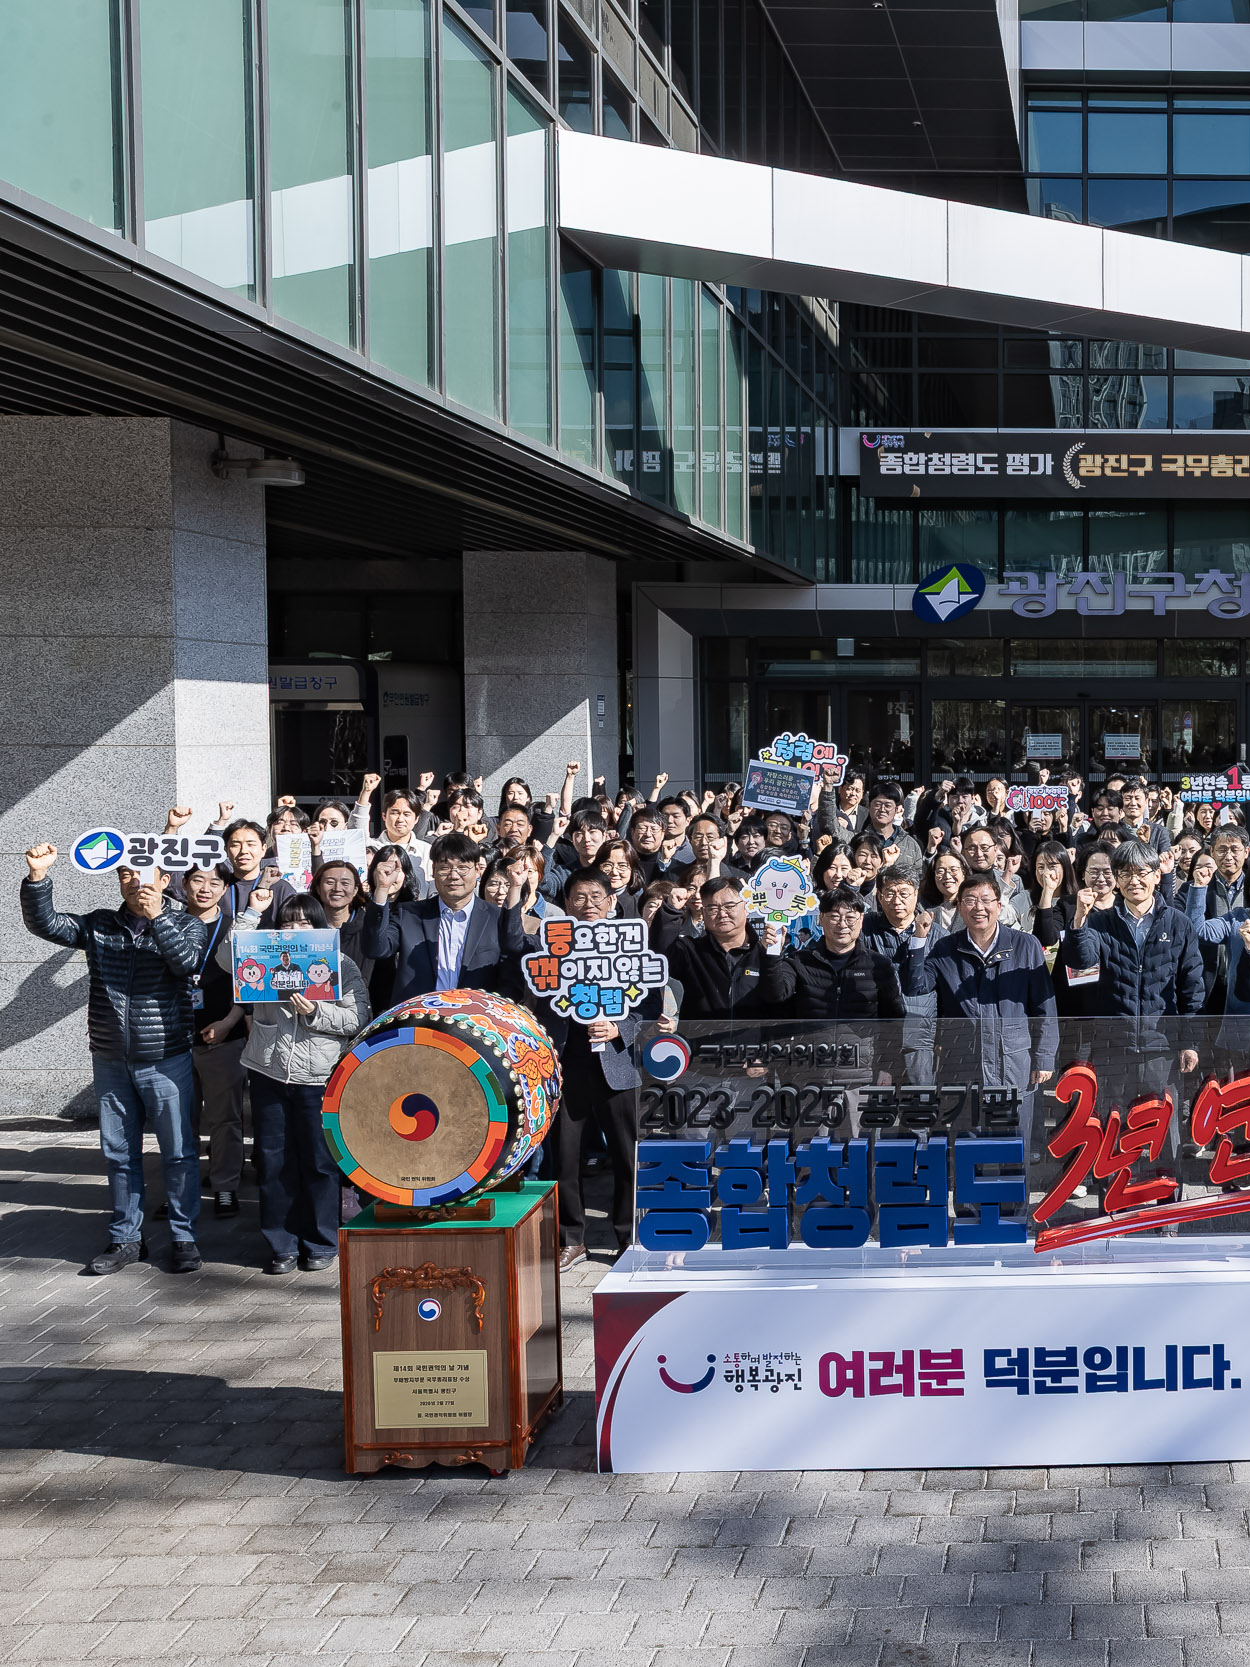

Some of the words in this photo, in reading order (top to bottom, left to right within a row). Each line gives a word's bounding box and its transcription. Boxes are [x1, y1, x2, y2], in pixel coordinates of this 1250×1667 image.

[880, 453, 999, 475] 종합청렴도
[1006, 453, 1054, 475] 평가
[1078, 454, 1154, 478] 광진구
[774, 735, 834, 761] 청렴에
[1180, 790, 1213, 802] 여러분
[127, 835, 223, 869] 광진구
[547, 922, 642, 956] 중요한건
[528, 957, 610, 990] 꺾이지
[615, 956, 662, 982] 않는
[570, 983, 623, 1018] 청렴
[640, 1083, 849, 1130] 2023-2025
[857, 1085, 1023, 1129] 공공기관
[635, 1137, 1028, 1251] 종합청렴도
[722, 1352, 761, 1367] 소통하며
[762, 1351, 802, 1366] 발전하는
[818, 1348, 966, 1398] 여러분
[983, 1344, 1242, 1396] 덕분입니다.
[724, 1366, 802, 1393] 행복광진
